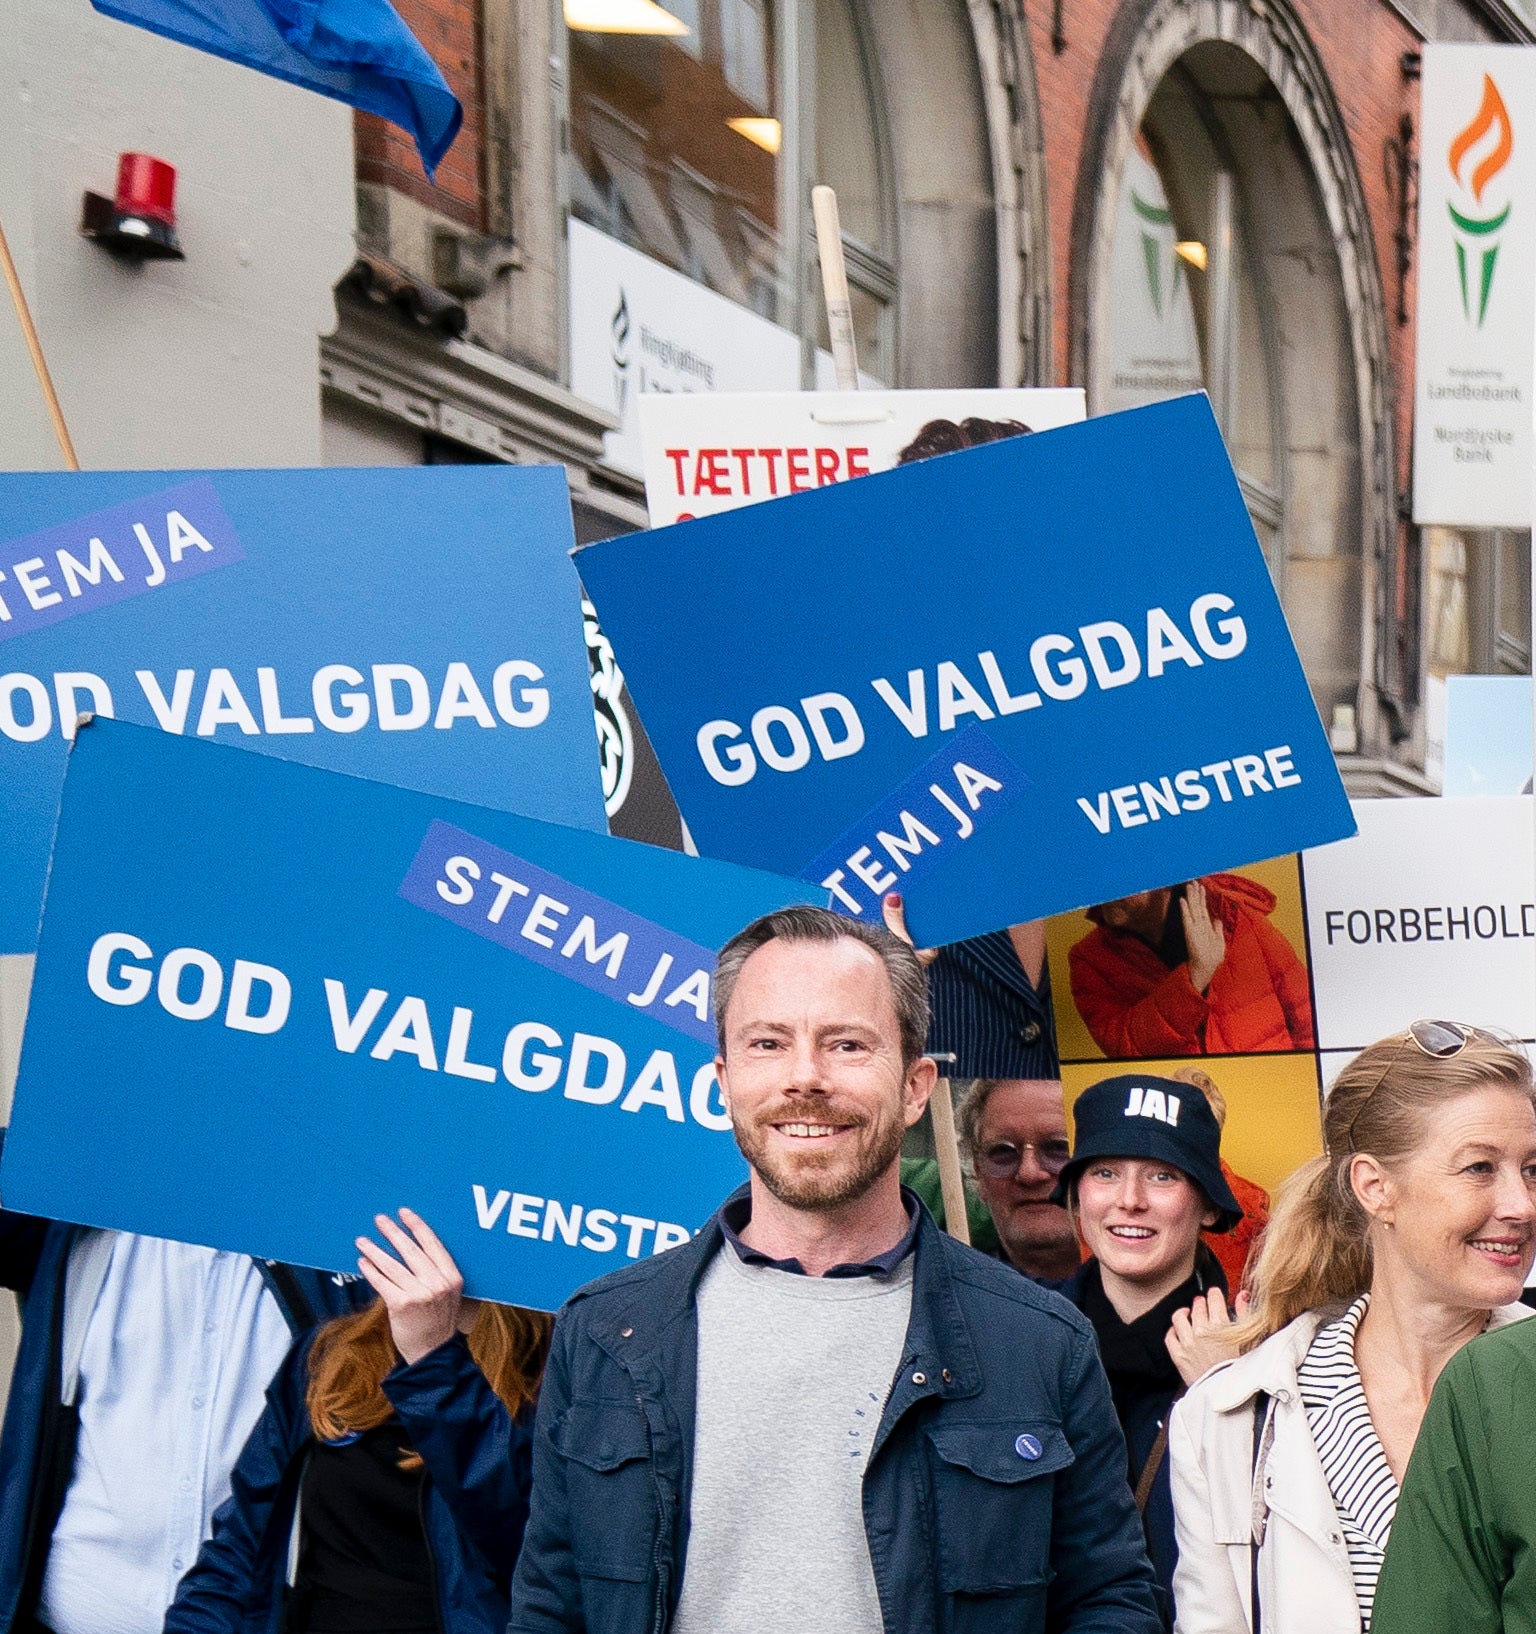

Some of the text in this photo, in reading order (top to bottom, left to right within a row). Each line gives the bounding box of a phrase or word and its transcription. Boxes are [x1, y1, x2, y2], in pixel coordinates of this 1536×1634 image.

[132, 510, 214, 587] JA
[0, 660, 551, 742] OD VALGDAG
[697, 592, 1248, 786] GOD VALGDAG
[1076, 746, 1301, 836] VENSTRE
[820, 761, 1004, 916] TEM JA
[435, 854, 715, 1023] STEM JA
[86, 932, 733, 1133] GOD VALGDAG
[1124, 1087, 1180, 1128] JA!
[471, 1184, 701, 1260] VENSTR
